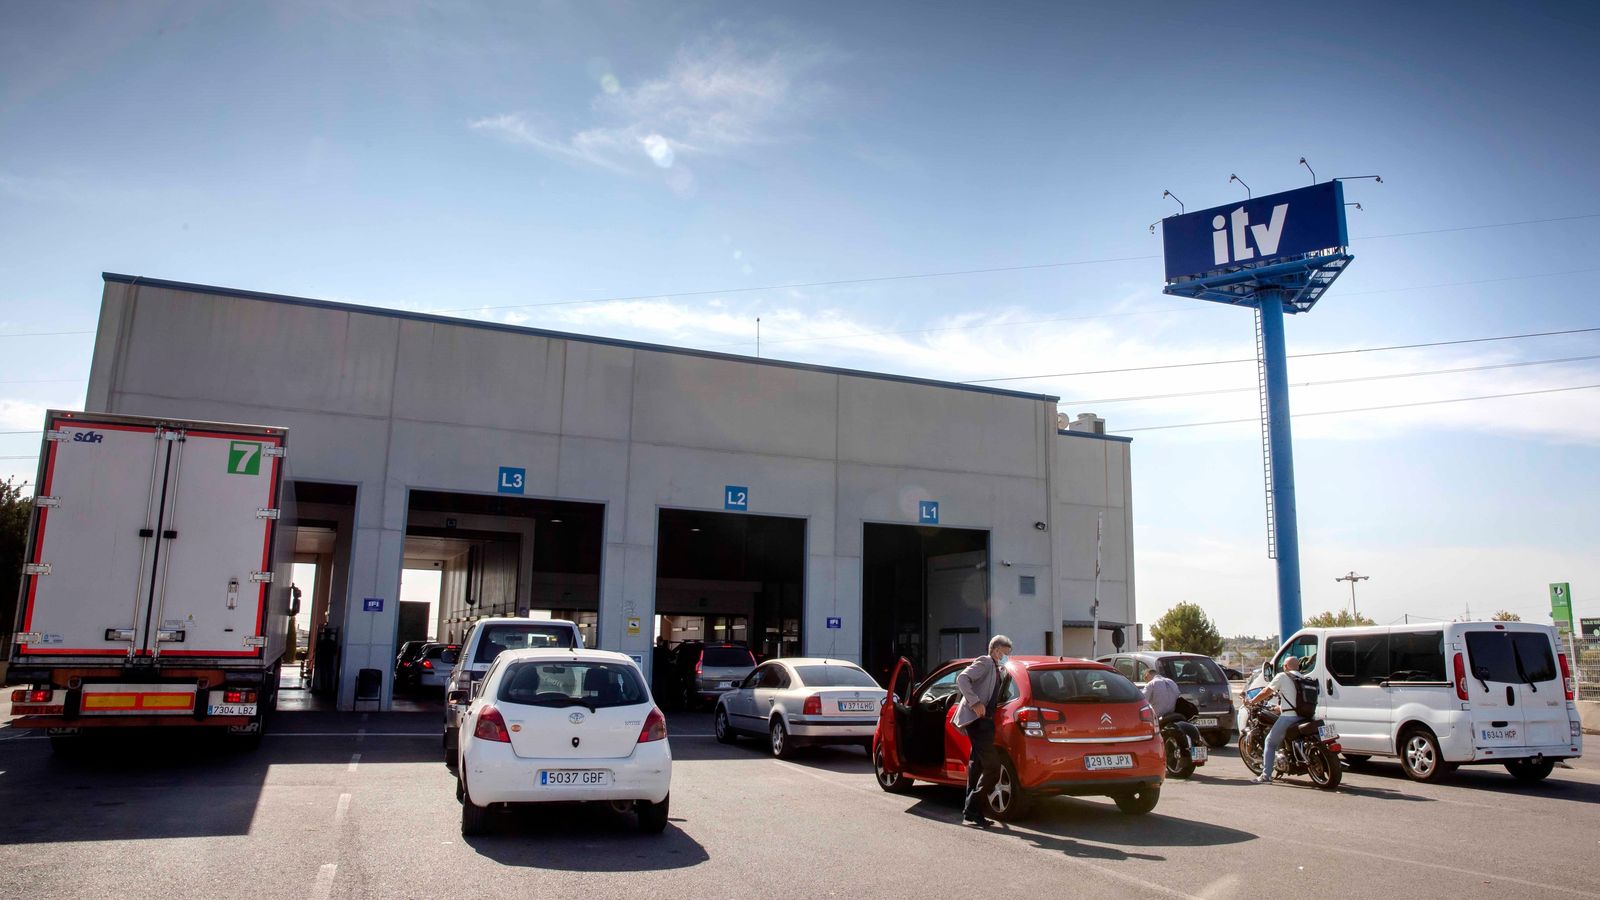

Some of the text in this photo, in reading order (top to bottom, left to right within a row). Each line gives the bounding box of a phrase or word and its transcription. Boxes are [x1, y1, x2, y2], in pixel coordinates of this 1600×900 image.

[1212, 203, 1289, 266] itv
[233, 443, 259, 473] 7
[502, 472, 523, 488] L3
[728, 491, 746, 505] L2
[922, 506, 936, 518] L1
[214, 706, 254, 714] 7304 LBZ
[1487, 731, 1503, 739] 6343
[1091, 755, 1130, 767] 2918 JPX
[549, 772, 605, 784] 5037 GBF
